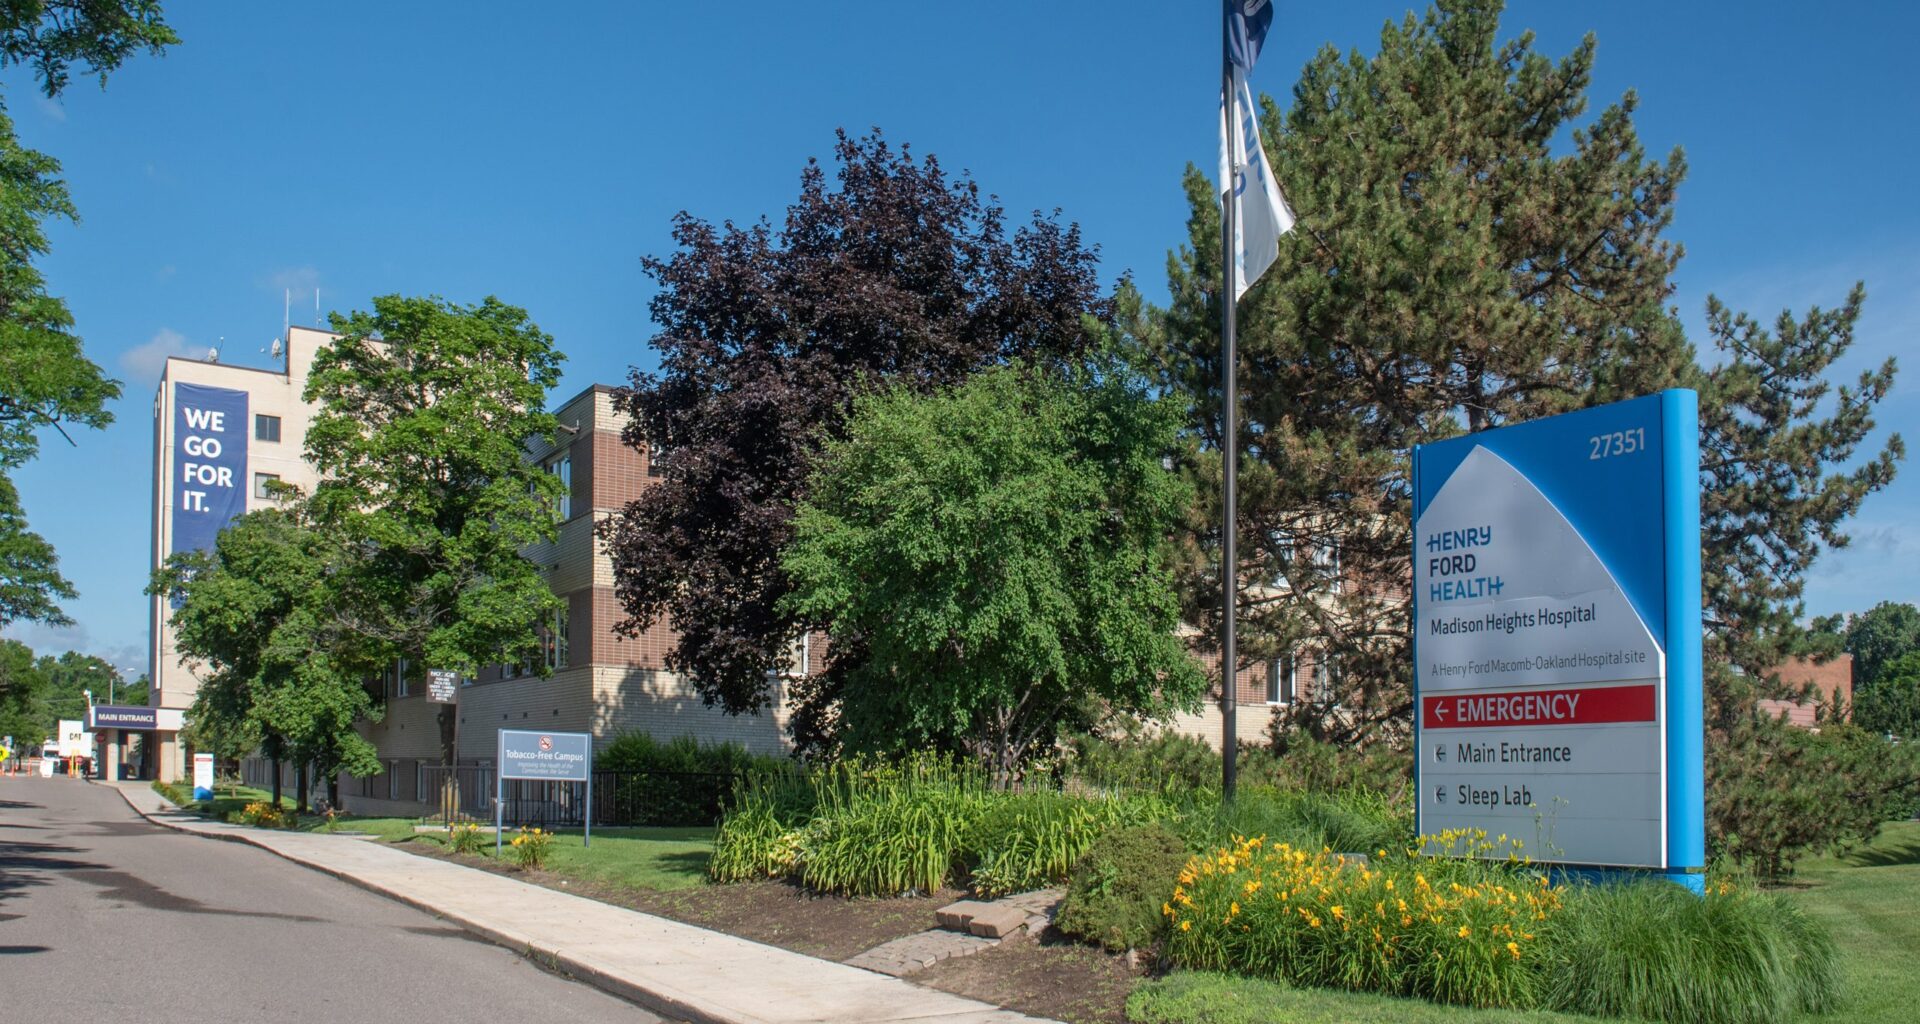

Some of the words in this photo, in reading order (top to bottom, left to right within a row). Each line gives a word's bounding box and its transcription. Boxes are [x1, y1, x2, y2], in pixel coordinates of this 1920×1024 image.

[184, 408, 224, 432] WE
[184, 436, 221, 458] GO
[1590, 428, 1644, 460] 27351
[184, 463, 233, 487] FOR
[183, 490, 209, 512] IT.
[1427, 525, 1491, 552] HENRY
[1430, 554, 1476, 577] FORD
[1430, 576, 1504, 602] HEALTH
[1431, 617, 1483, 635] Madison
[1486, 611, 1535, 634] Heights
[1538, 603, 1596, 628] Hospital
[1431, 665, 1439, 676] A
[1439, 663, 1467, 678] Henry
[1468, 659, 1490, 675] Ford
[1491, 653, 1577, 673] Macomb-Oakland
[1578, 650, 1623, 669] Hospital
[1624, 651, 1646, 664] site
[98, 713, 117, 721] MAIN
[118, 714, 154, 722] ENTRANCE
[1457, 693, 1580, 722] EMERGENCY
[506, 749, 553, 760] Tobacco-Free
[554, 751, 584, 762] Campus
[1457, 743, 1496, 763] Main
[1500, 742, 1571, 763] Entrance
[1458, 785, 1499, 810] Sleep
[1504, 784, 1532, 806] Lab
